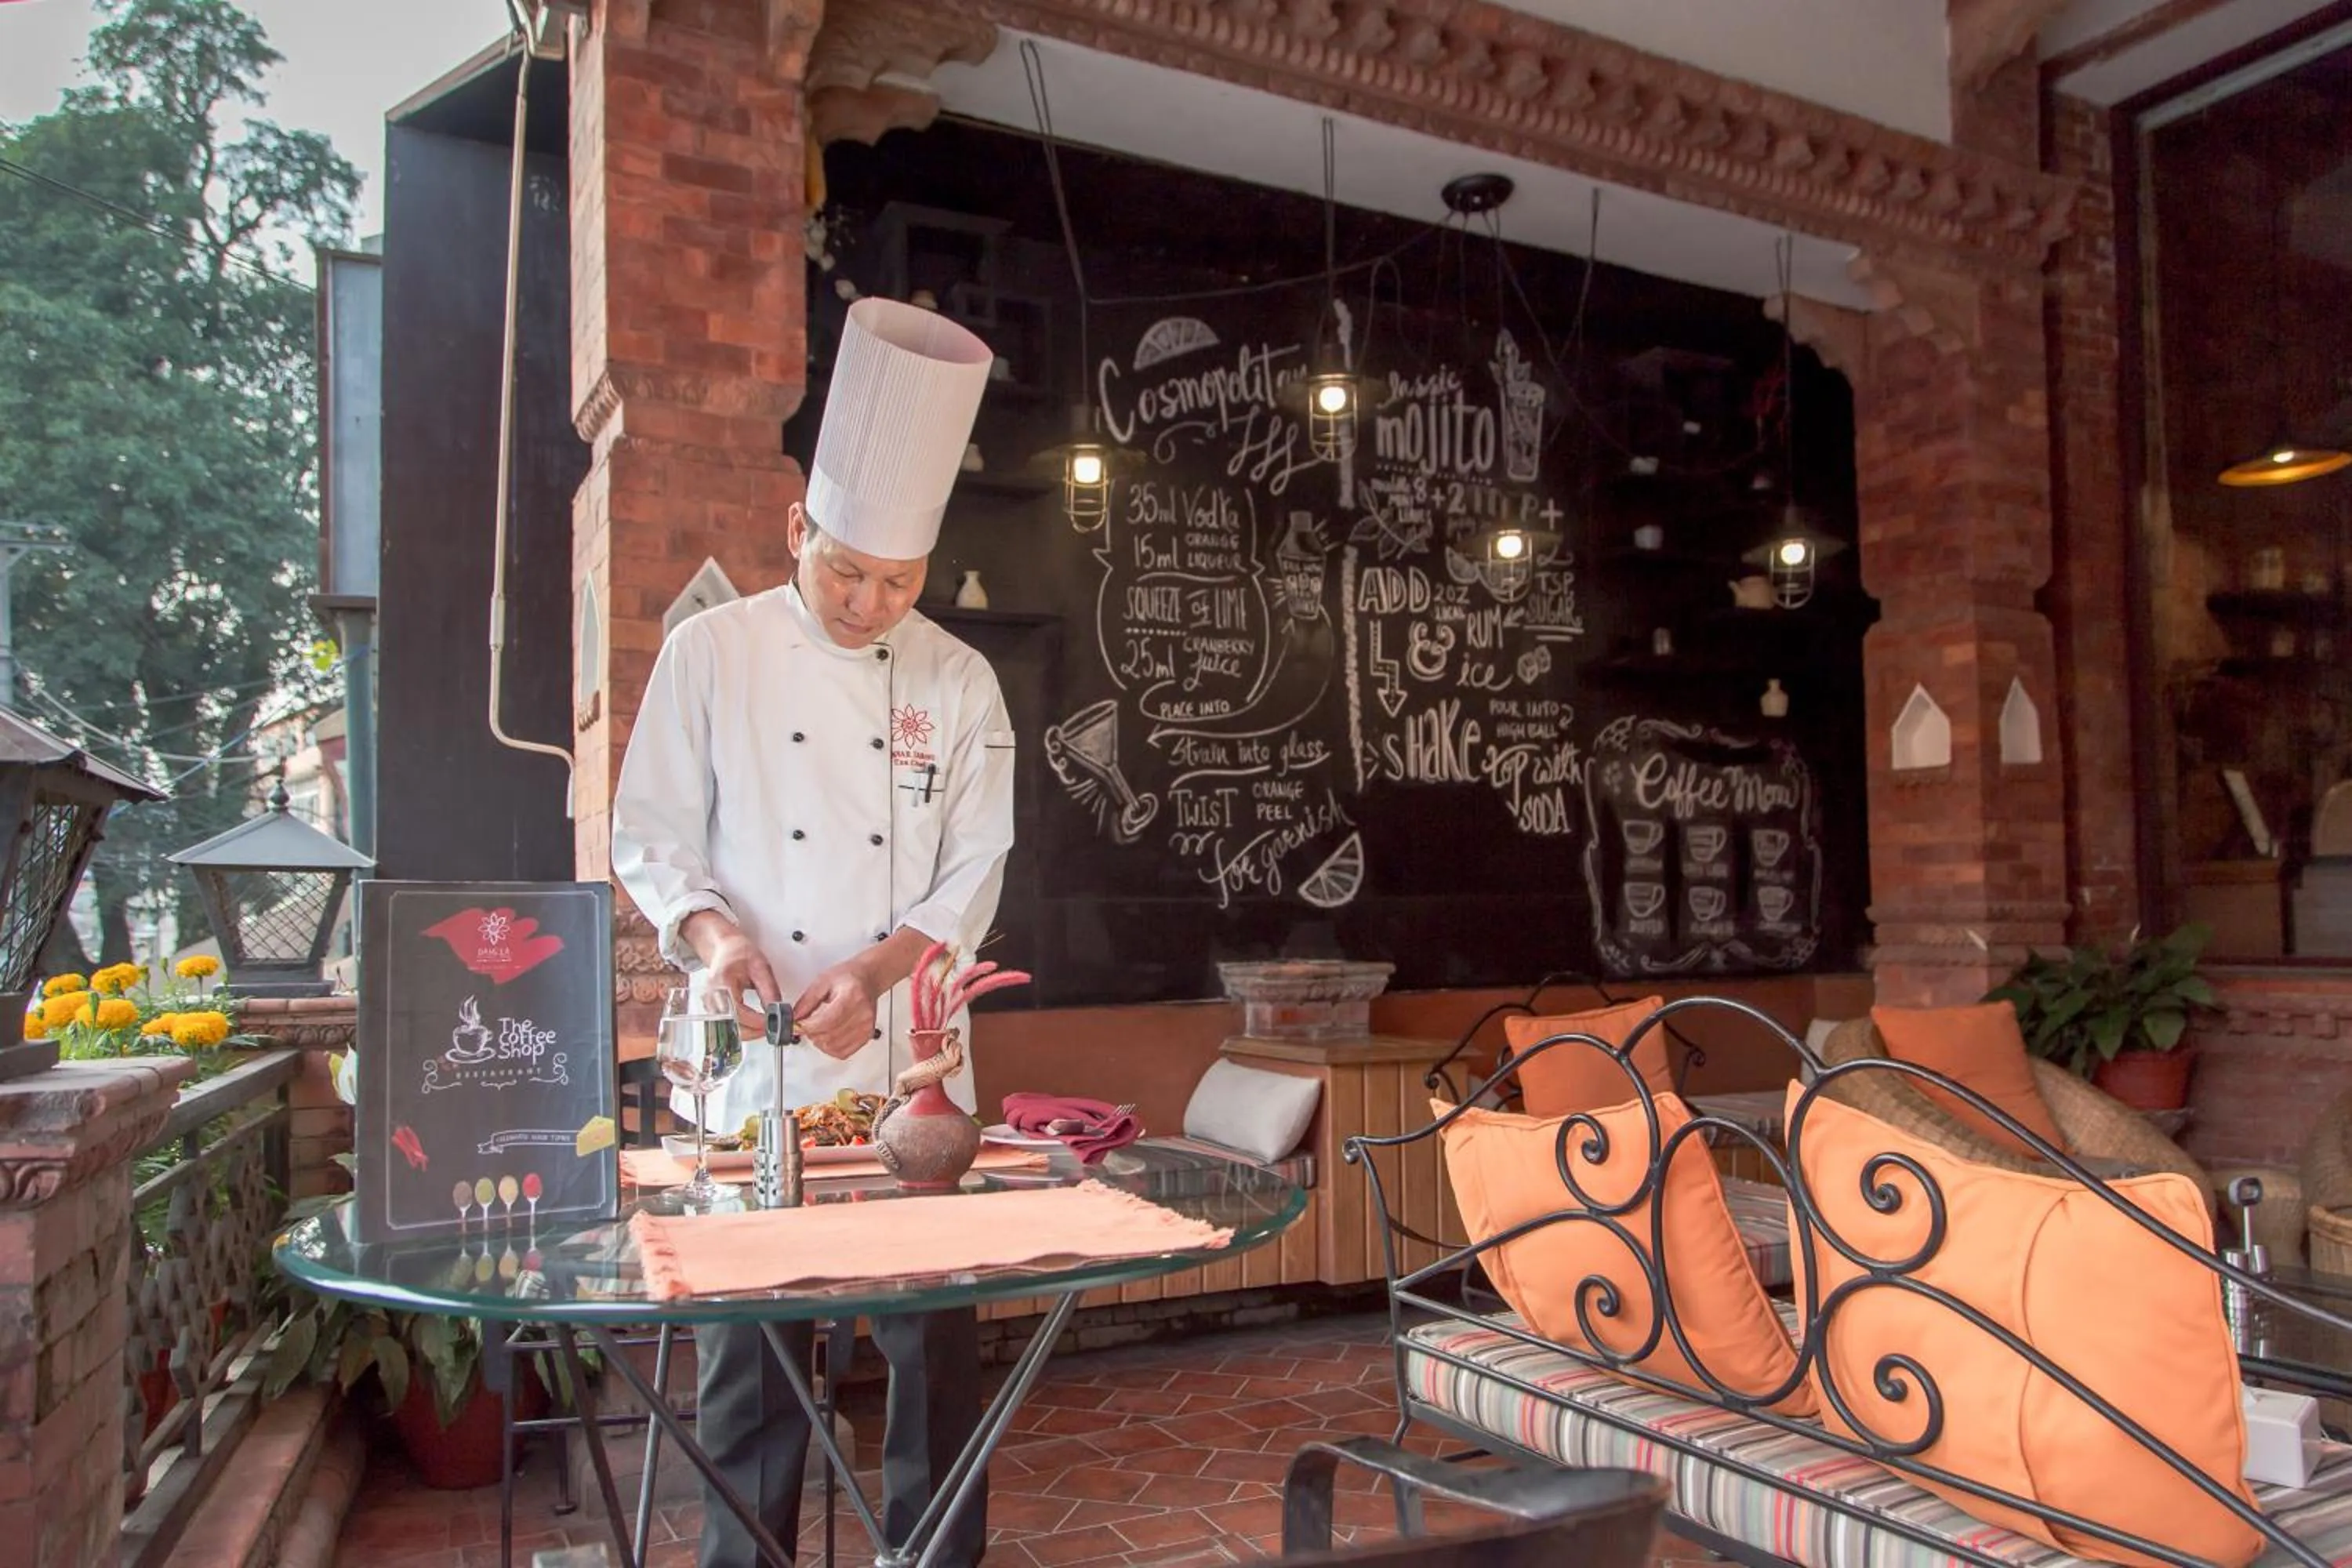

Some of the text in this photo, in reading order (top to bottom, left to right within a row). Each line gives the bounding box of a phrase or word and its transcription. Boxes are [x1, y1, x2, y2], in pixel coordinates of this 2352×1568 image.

[1127, 482, 1240, 533] 35ml Vodka
[1134, 533, 1179, 569] 15ml
[1185, 532, 1240, 549] ORANGE
[1187, 552, 1248, 573] LIQUEUR
[1123, 586, 1181, 623] SQUEEZE
[1215, 588, 1247, 630] LIME
[1358, 566, 1431, 614] ADD
[1182, 637, 1254, 655] CRANBERRY
[1467, 604, 1504, 649] RUM
[1120, 637, 1175, 679] 25ml
[1456, 652, 1514, 691] ice
[1160, 700, 1230, 718] PLACE INTO
[1526, 700, 1559, 717] INTO
[1167, 730, 1325, 777] Strain into glass
[1533, 741, 1583, 785] with
[1252, 780, 1304, 800] ORANGE
[1631, 752, 1730, 819] Coffee
[1168, 787, 1239, 828] TWIST
[1256, 802, 1293, 822] PEEL
[1518, 786, 1572, 835] SODA
[1261, 787, 1356, 896] garnish
[497, 1017, 532, 1033] The
